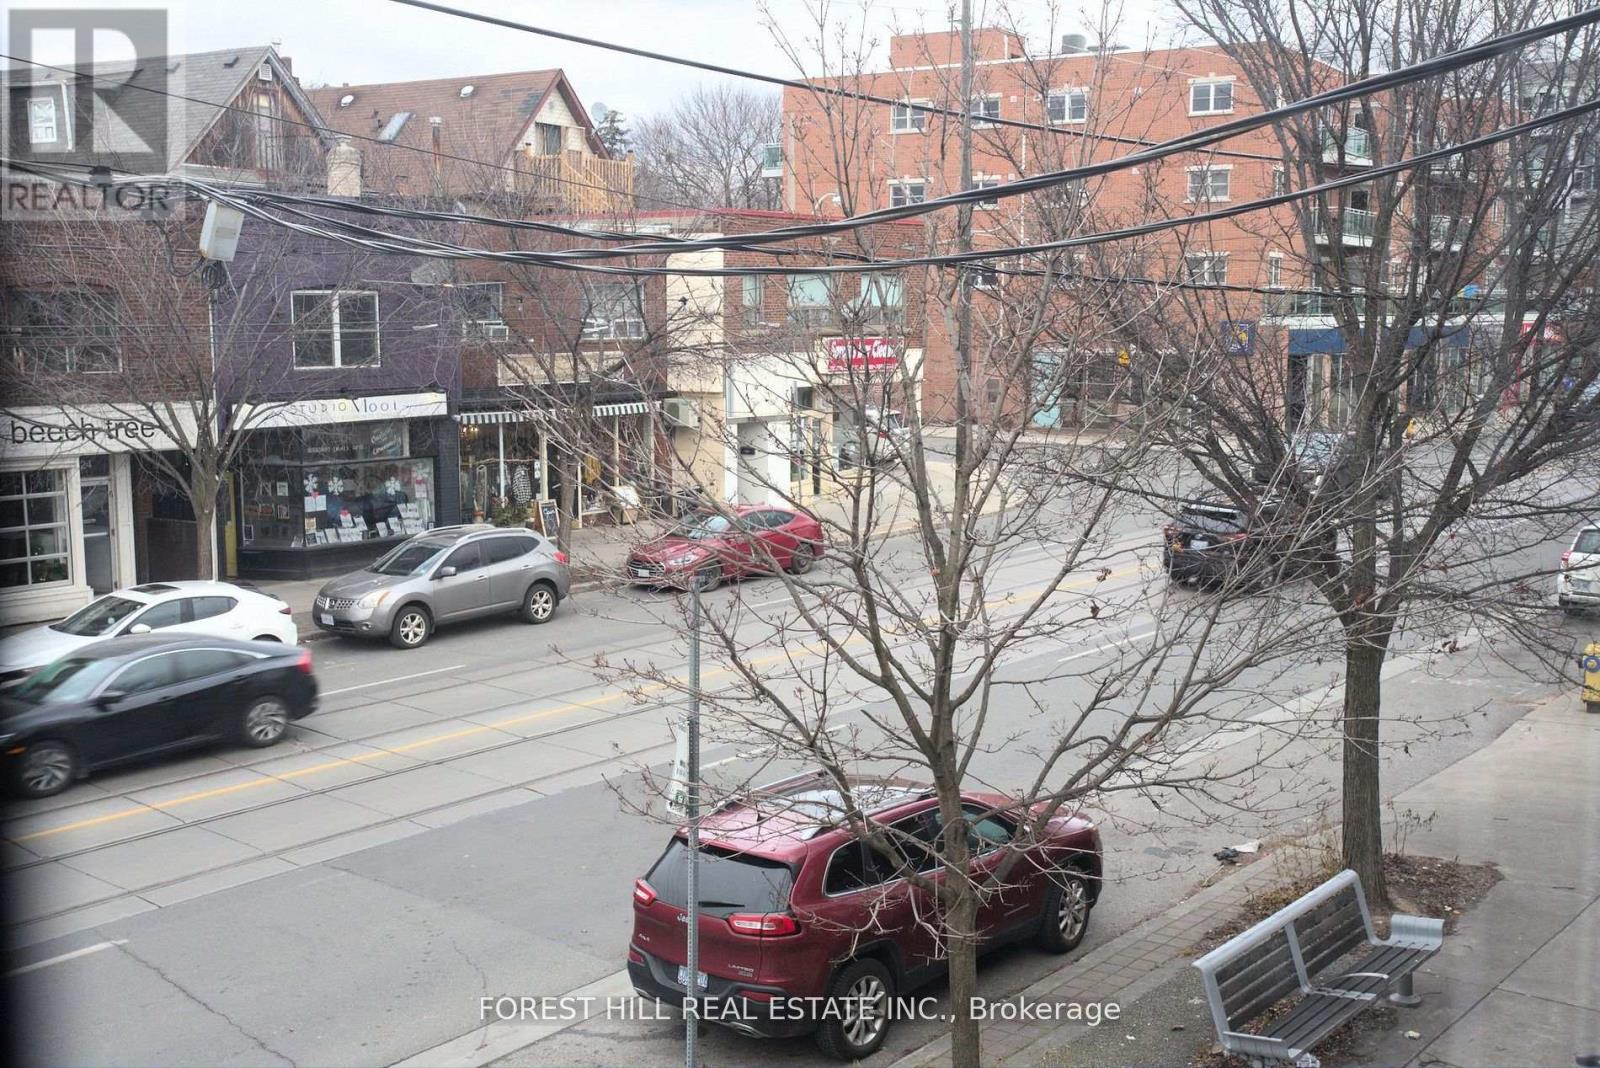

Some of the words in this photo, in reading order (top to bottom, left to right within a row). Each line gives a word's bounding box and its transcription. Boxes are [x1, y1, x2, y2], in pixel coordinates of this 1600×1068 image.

[291, 402, 347, 415] STUDIO
[11, 417, 95, 444] beech
[106, 420, 155, 440] tree
